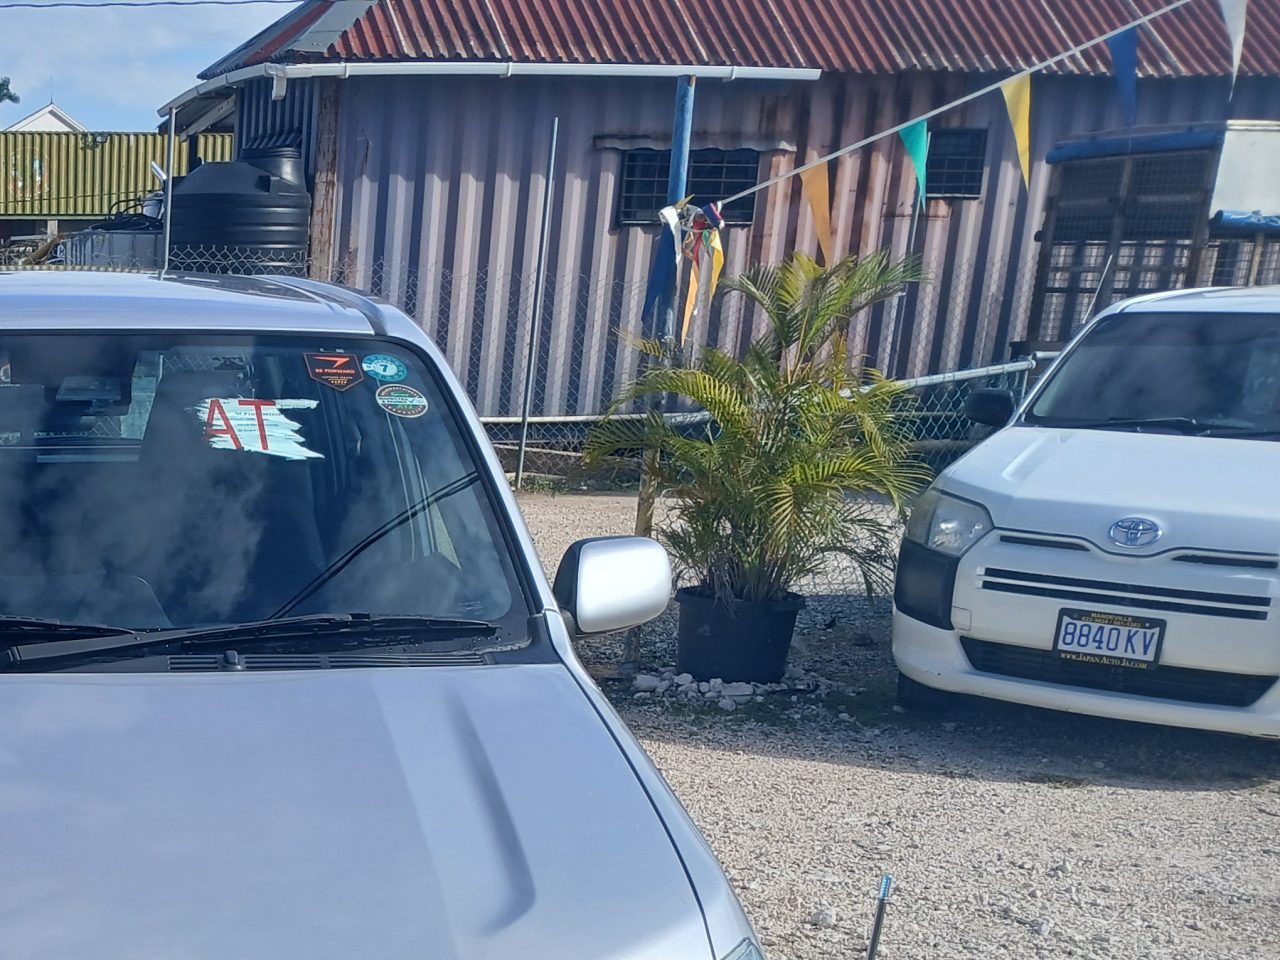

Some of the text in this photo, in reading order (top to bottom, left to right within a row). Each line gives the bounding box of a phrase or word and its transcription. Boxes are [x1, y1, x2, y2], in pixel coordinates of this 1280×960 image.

[380, 364, 388, 372] 7
[206, 399, 277, 451] AT
[1062, 622, 1121, 651] 8840
[1124, 630, 1156, 655] KV
